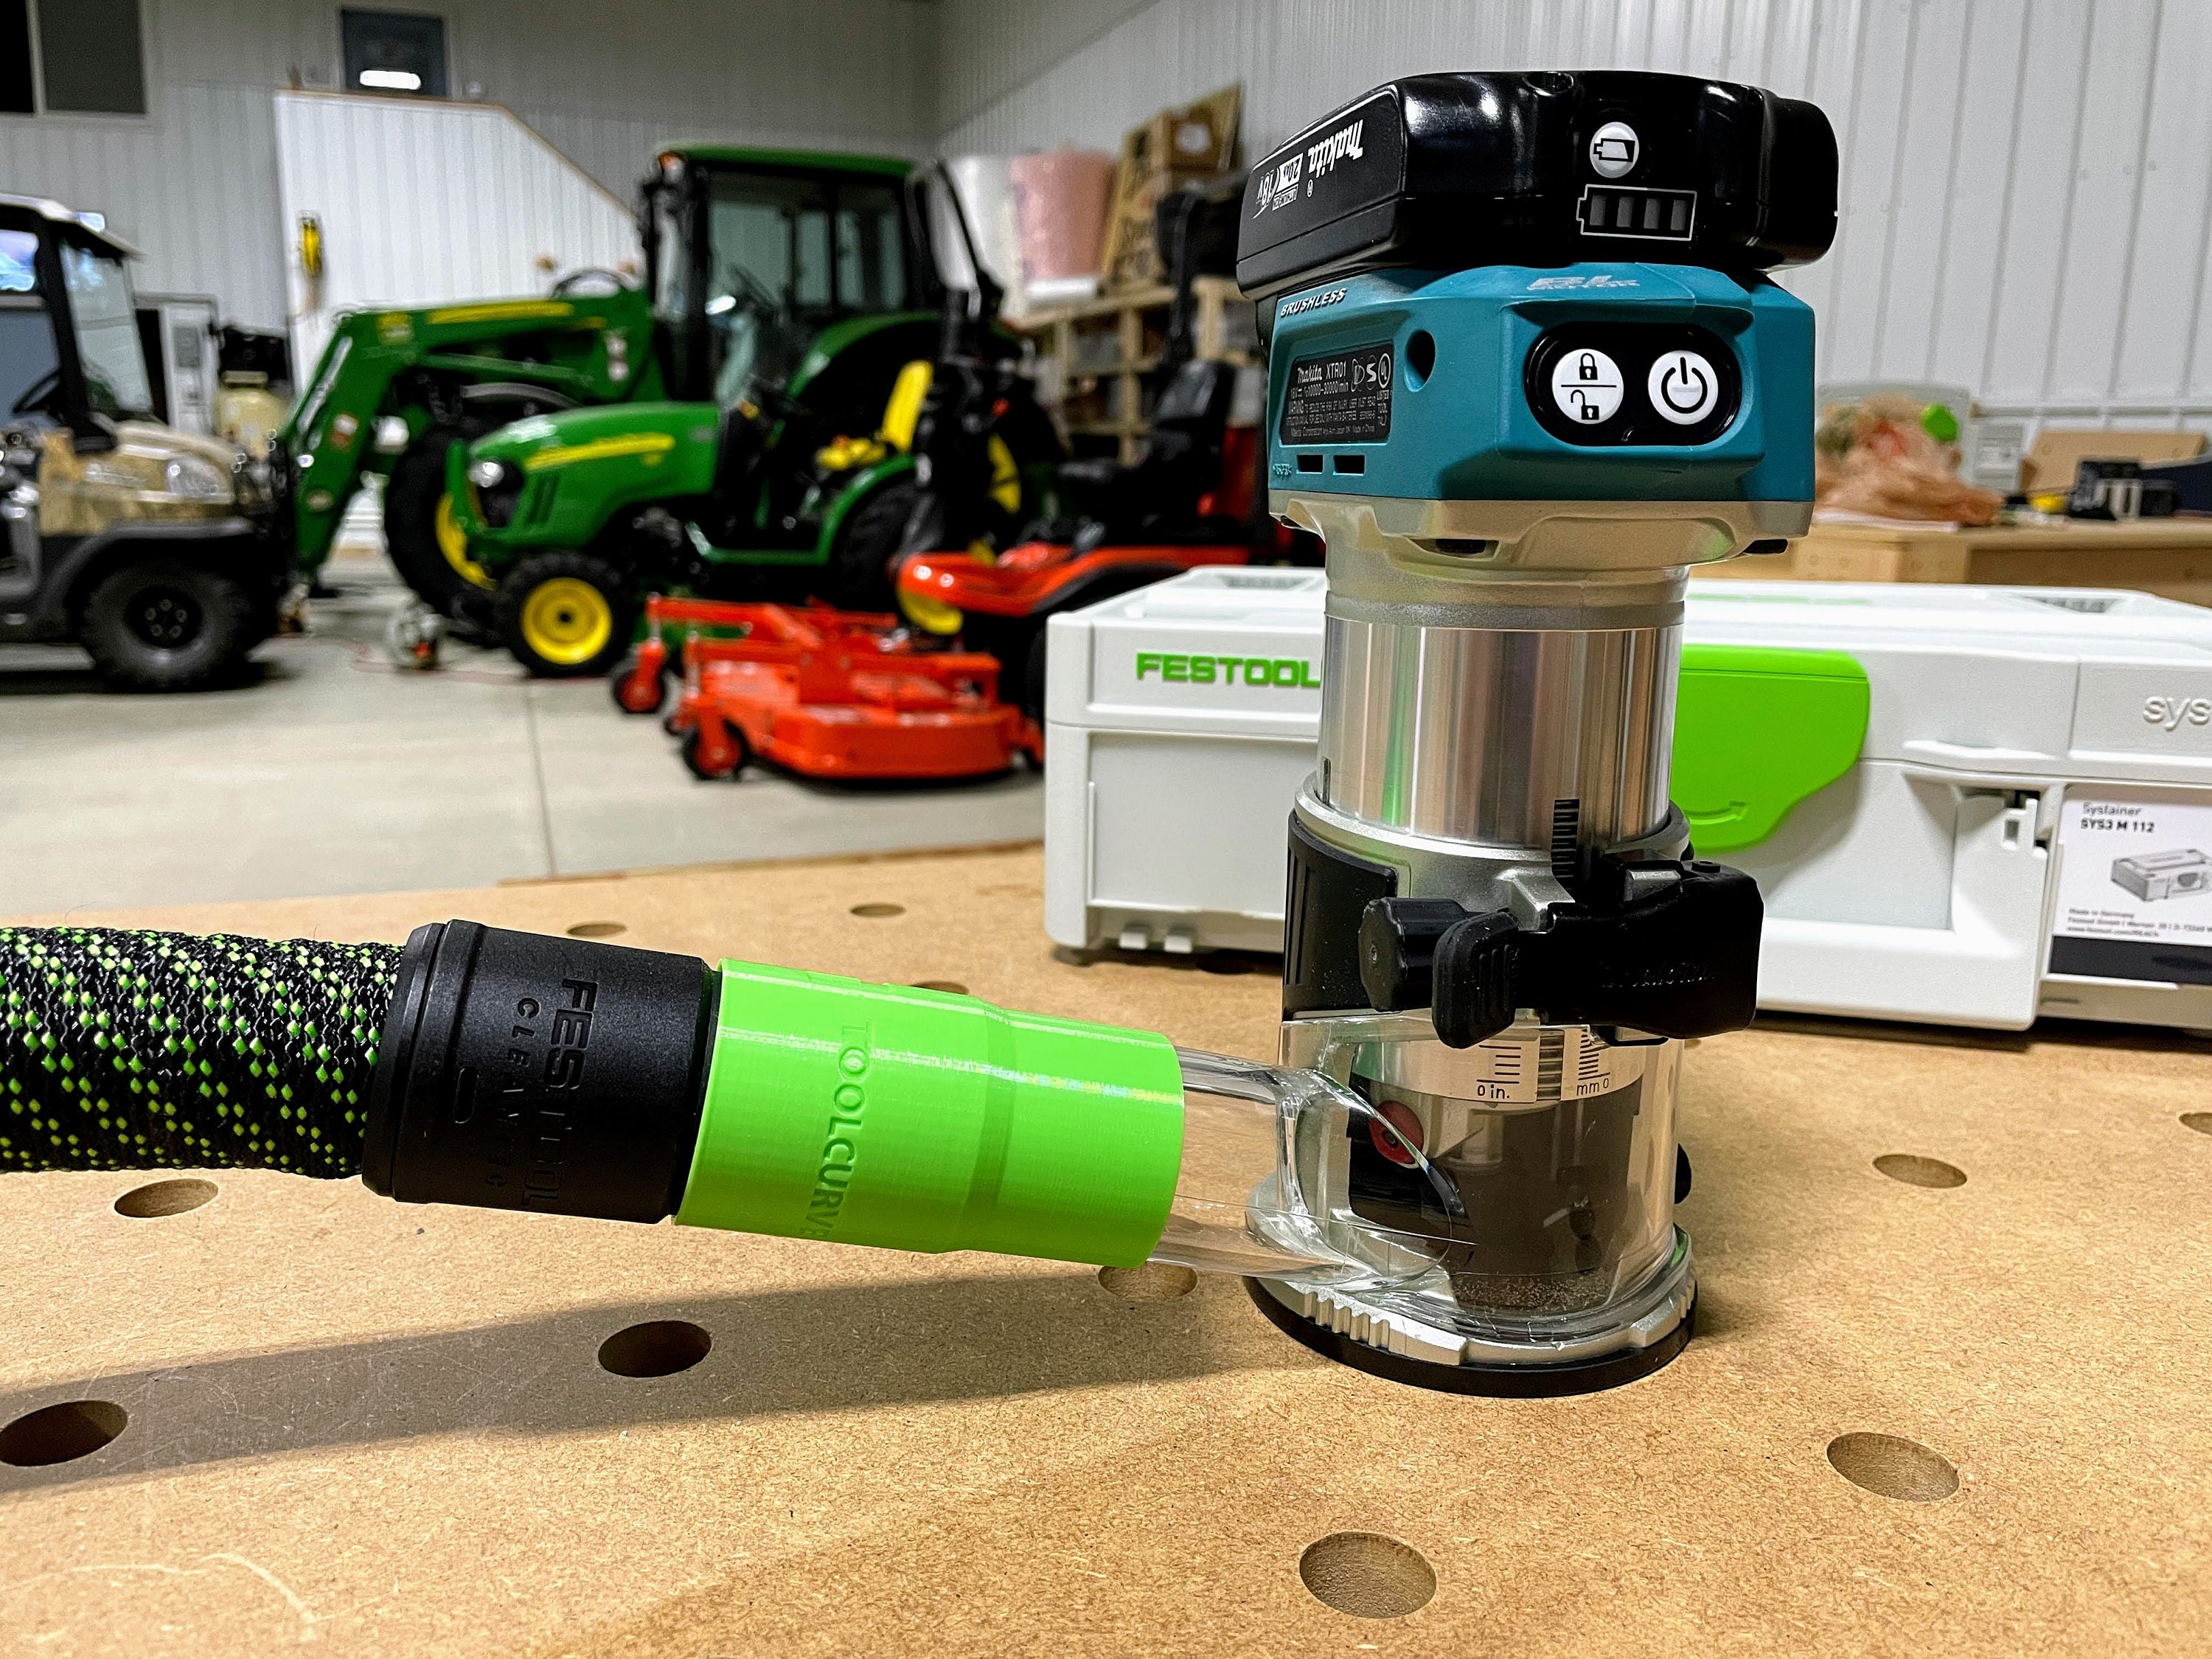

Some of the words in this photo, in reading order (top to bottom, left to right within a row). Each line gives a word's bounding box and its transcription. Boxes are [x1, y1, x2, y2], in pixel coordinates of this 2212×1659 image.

[1280, 288, 1347, 317] BRUSHLESS
[1326, 361, 1346, 380] XTR01
[1136, 652, 1321, 689] FESTOOL
[2081, 818, 2113, 831] SYS3
[2116, 819, 2127, 831] M
[2132, 821, 2155, 833] 112
[1576, 1082, 1599, 1096] mm
